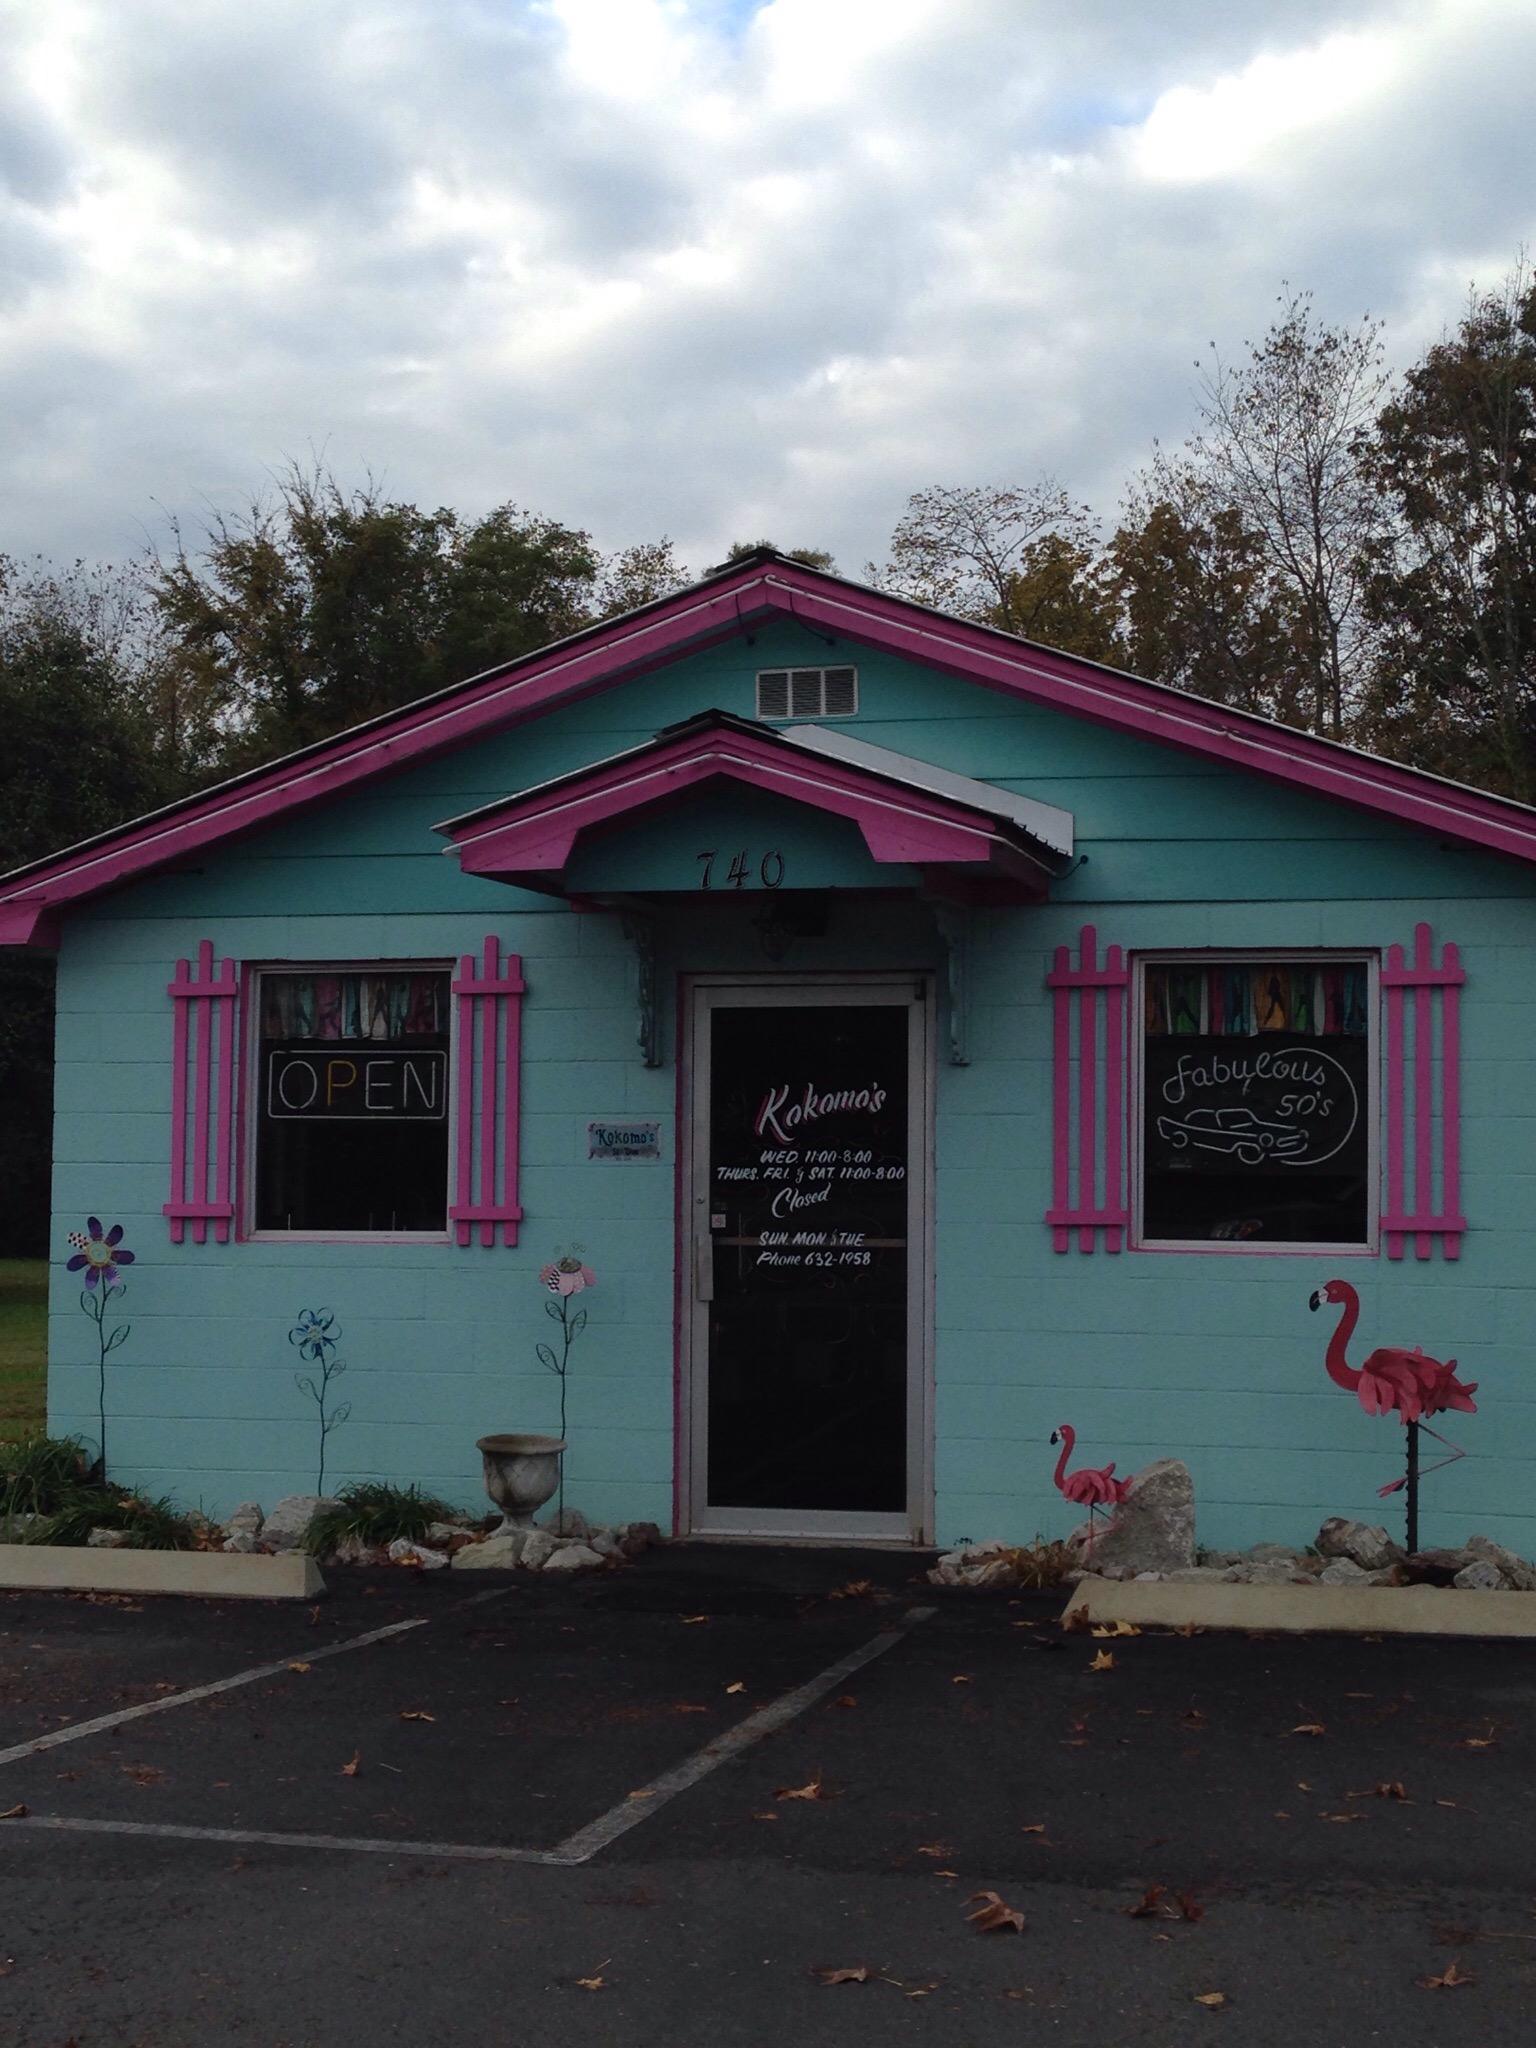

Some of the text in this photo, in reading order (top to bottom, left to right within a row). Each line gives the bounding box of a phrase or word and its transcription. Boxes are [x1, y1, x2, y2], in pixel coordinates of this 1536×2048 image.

[696, 849, 785, 888] 740
[279, 1060, 437, 1110] OPEN
[756, 1082, 888, 1143] Kokomo's
[1275, 1091, 1335, 1117] 50's
[595, 1128, 656, 1147] Kokomo's
[760, 1150, 799, 1165] WED.
[717, 1166, 760, 1181] THURS.
[763, 1167, 790, 1180] FRI.
[808, 1167, 834, 1180] SAT.
[772, 1182, 832, 1219] Closed
[758, 1231, 788, 1246] SUN.
[756, 1251, 872, 1267] Phone 632-1958
